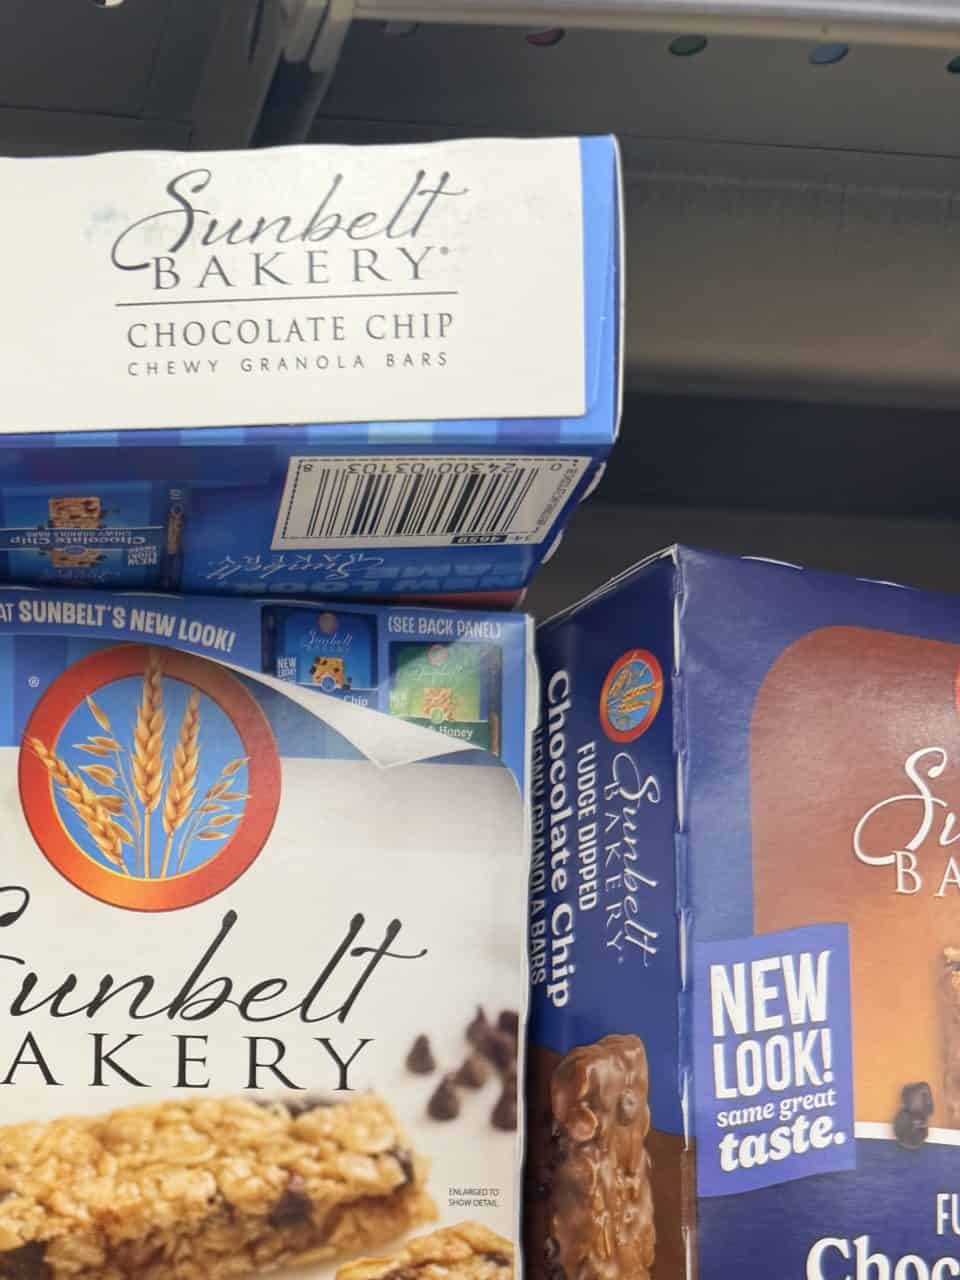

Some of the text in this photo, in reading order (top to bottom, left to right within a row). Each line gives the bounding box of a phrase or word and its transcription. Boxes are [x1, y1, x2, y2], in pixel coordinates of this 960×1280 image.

[111, 169, 470, 270] Sunbelt
[151, 246, 437, 291] BAKERY
[126, 312, 454, 350] CHOCOLATE CHIP
[126, 351, 448, 377] CHEWY GRANOLA BARS
[18, 599, 127, 630] SUNBELT'S
[129, 612, 176, 638] NEW
[177, 617, 237, 654] LOOK!
[387, 616, 416, 635] (SEE
[418, 616, 453, 636] BACK
[546, 670, 576, 1009] Chocolate Chip
[576, 741, 598, 911] FUDGE DIPPED
[603, 781, 625, 951] BAKERY
[612, 752, 662, 967] Sunbelt
[710, 948, 834, 1037] NEW
[712, 1028, 835, 1100] LOOK!
[717, 1088, 837, 1128] same great
[718, 1112, 847, 1173] taste.
